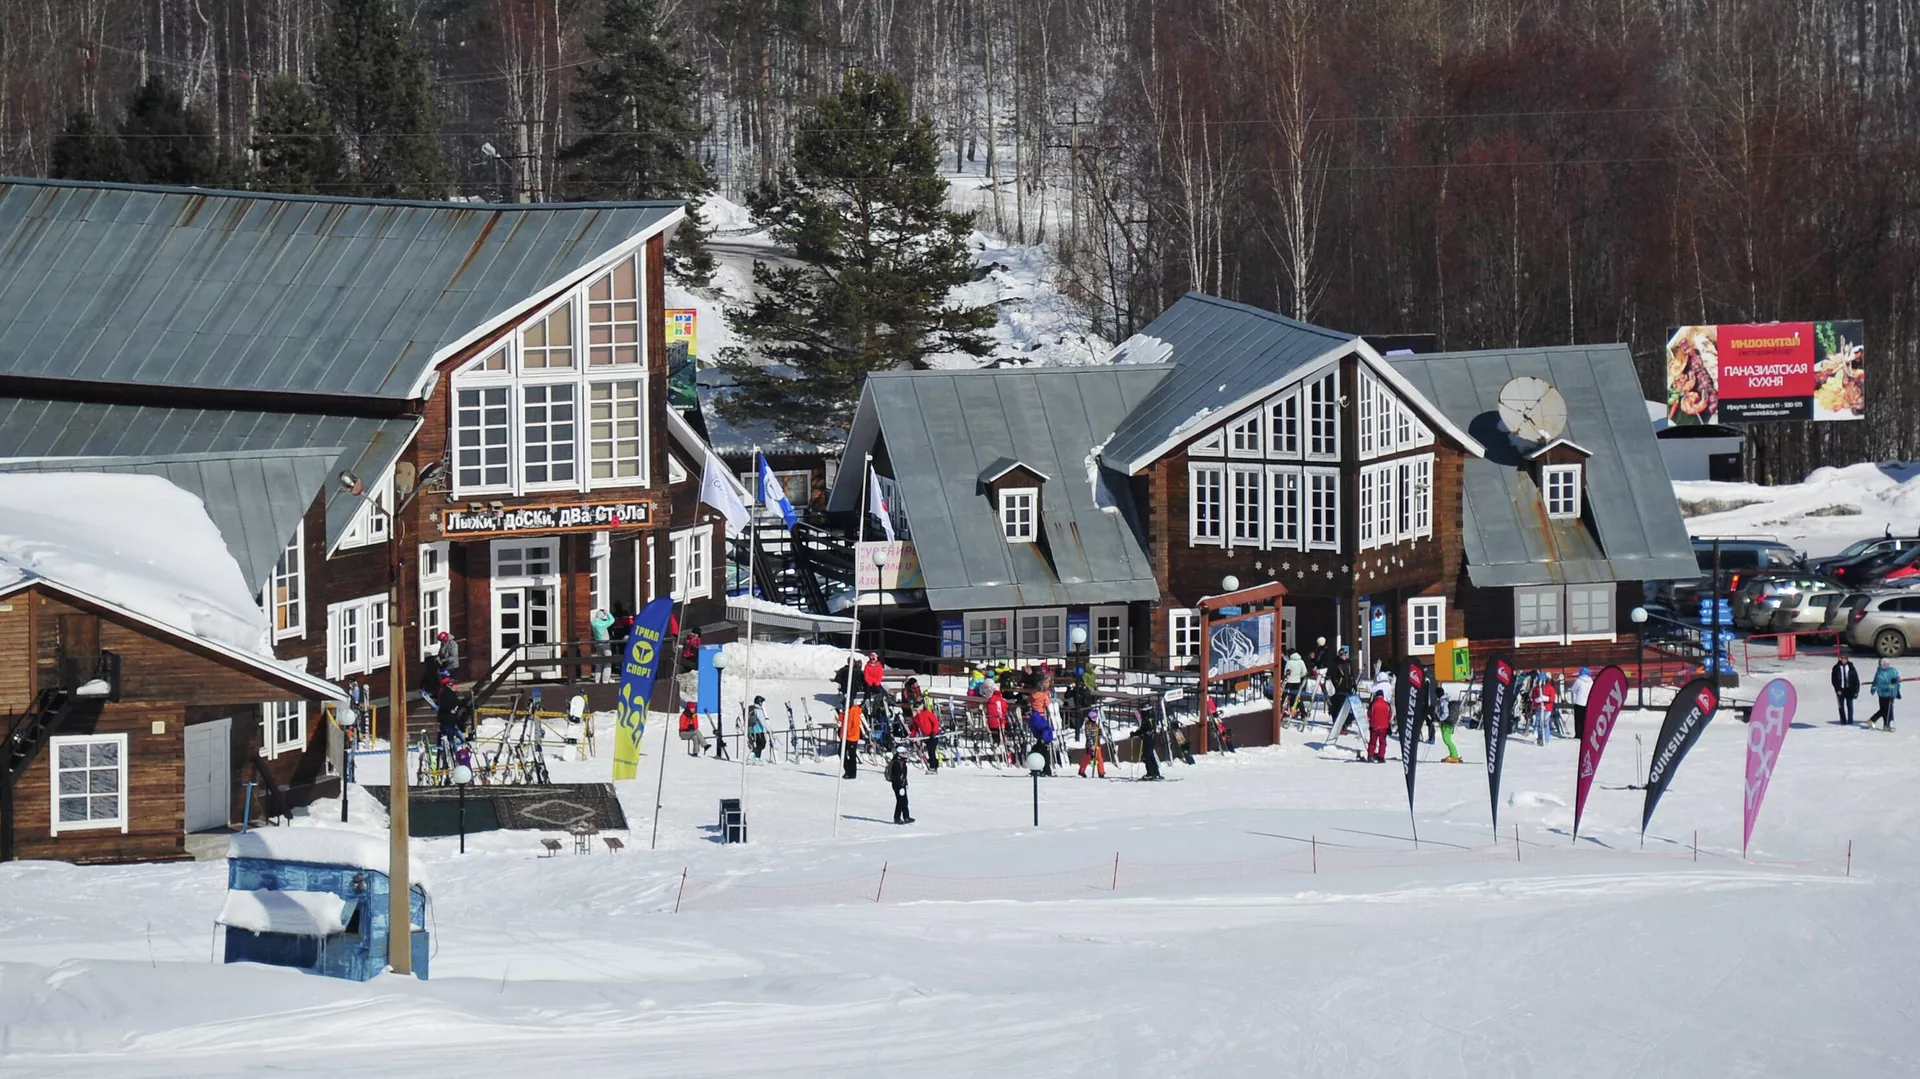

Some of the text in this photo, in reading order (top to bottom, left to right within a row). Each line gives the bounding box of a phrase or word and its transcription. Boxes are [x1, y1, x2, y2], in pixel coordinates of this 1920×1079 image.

[1724, 363, 1808, 376] ПАНАЗИАТСКАЯ
[1748, 376, 1784, 388] КУХНЯ
[635, 625, 660, 642] ТРИАЛ
[626, 662, 652, 678] СПОРТ
[1488, 682, 1506, 774] QUIKSILVER
[1650, 705, 1703, 784] QUIKSILVER
